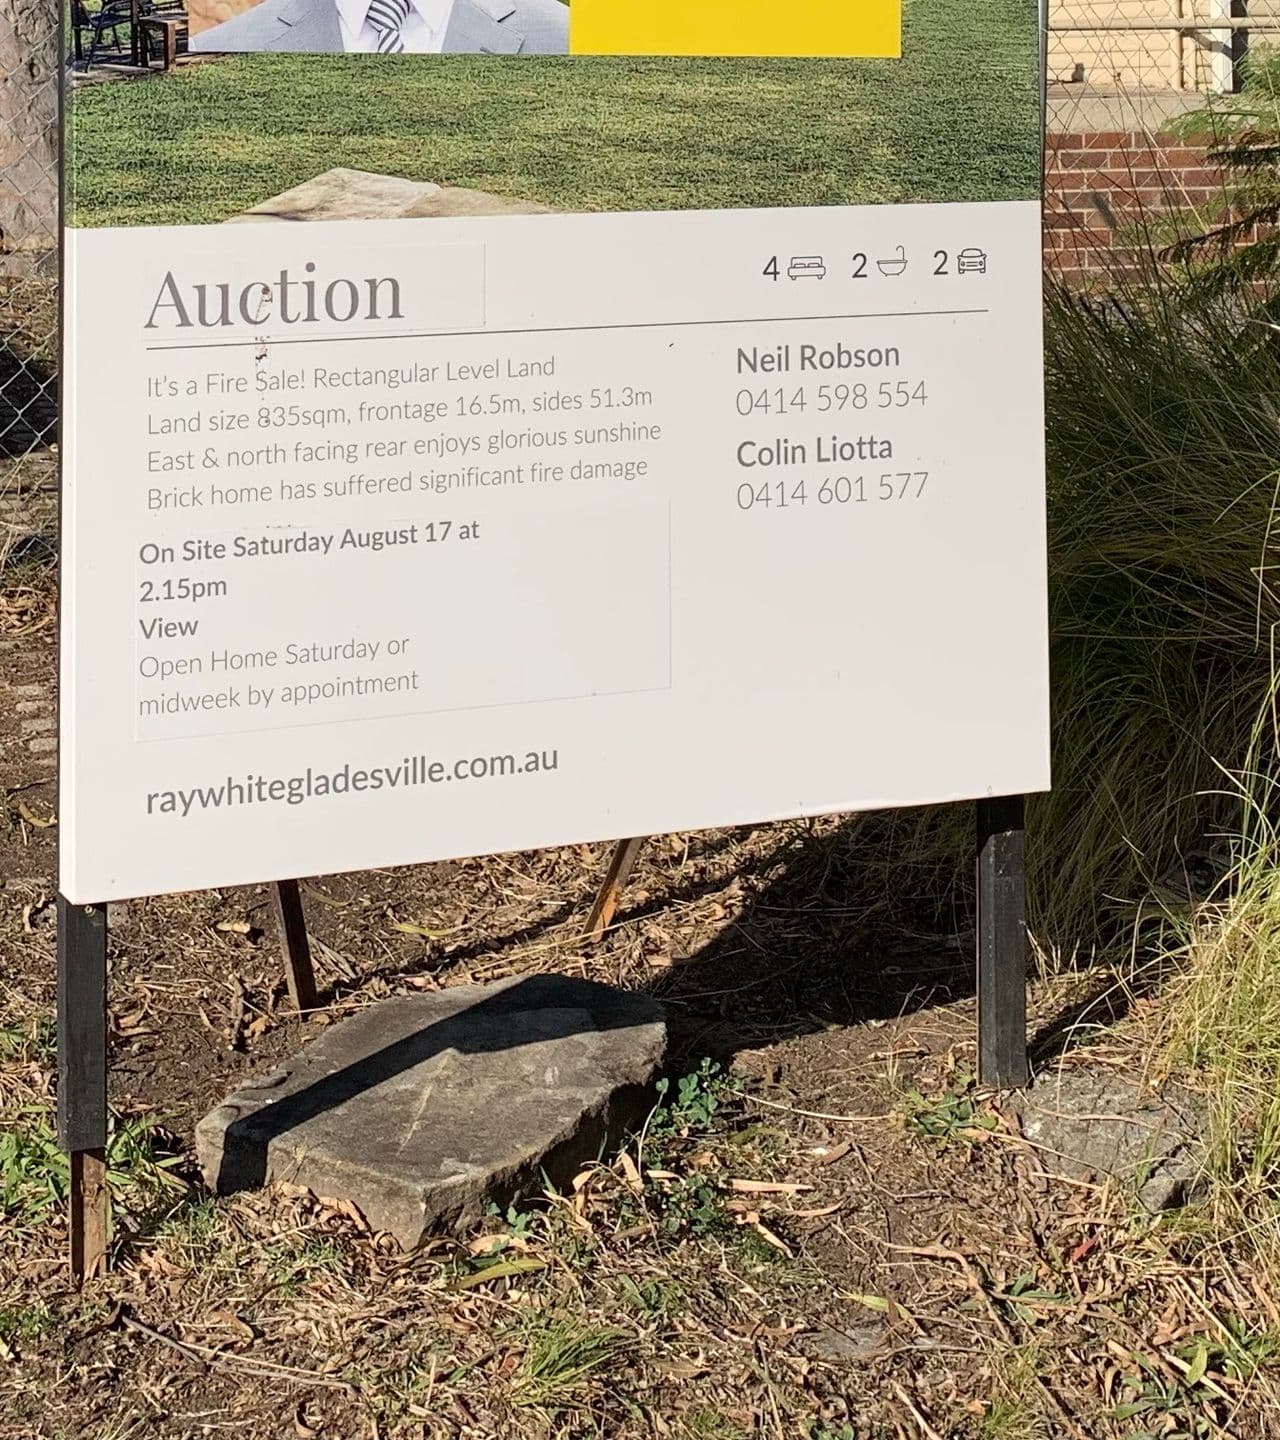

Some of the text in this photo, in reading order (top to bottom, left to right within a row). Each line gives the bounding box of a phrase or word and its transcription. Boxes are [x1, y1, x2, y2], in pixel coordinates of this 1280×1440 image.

[763, 250, 948, 281] 4 2 2
[144, 261, 405, 328] Auction
[147, 356, 555, 397] It's a Fire Sale! Rectangular Level Land
[737, 343, 900, 374] Neil Robson
[147, 387, 652, 435] Land size 835sqm, frontage 16.5m, sides 51.3m
[736, 381, 928, 416] 0414 598 554
[147, 421, 661, 473] East & north facing rear enjoys glorious sunshine
[737, 435, 893, 467] Colin Liotta
[147, 455, 648, 510] Brick home has suffered significant fire damage
[737, 472, 928, 510] 0414 601 577
[140, 519, 480, 565] On Site Saturday August 17 at
[140, 576, 228, 603] 2.15pm
[140, 615, 199, 640] View
[140, 634, 410, 683] Open Home Saturday or
[140, 671, 418, 716] midweek by appointment
[146, 744, 558, 816] raywhitegladesville.com.au
